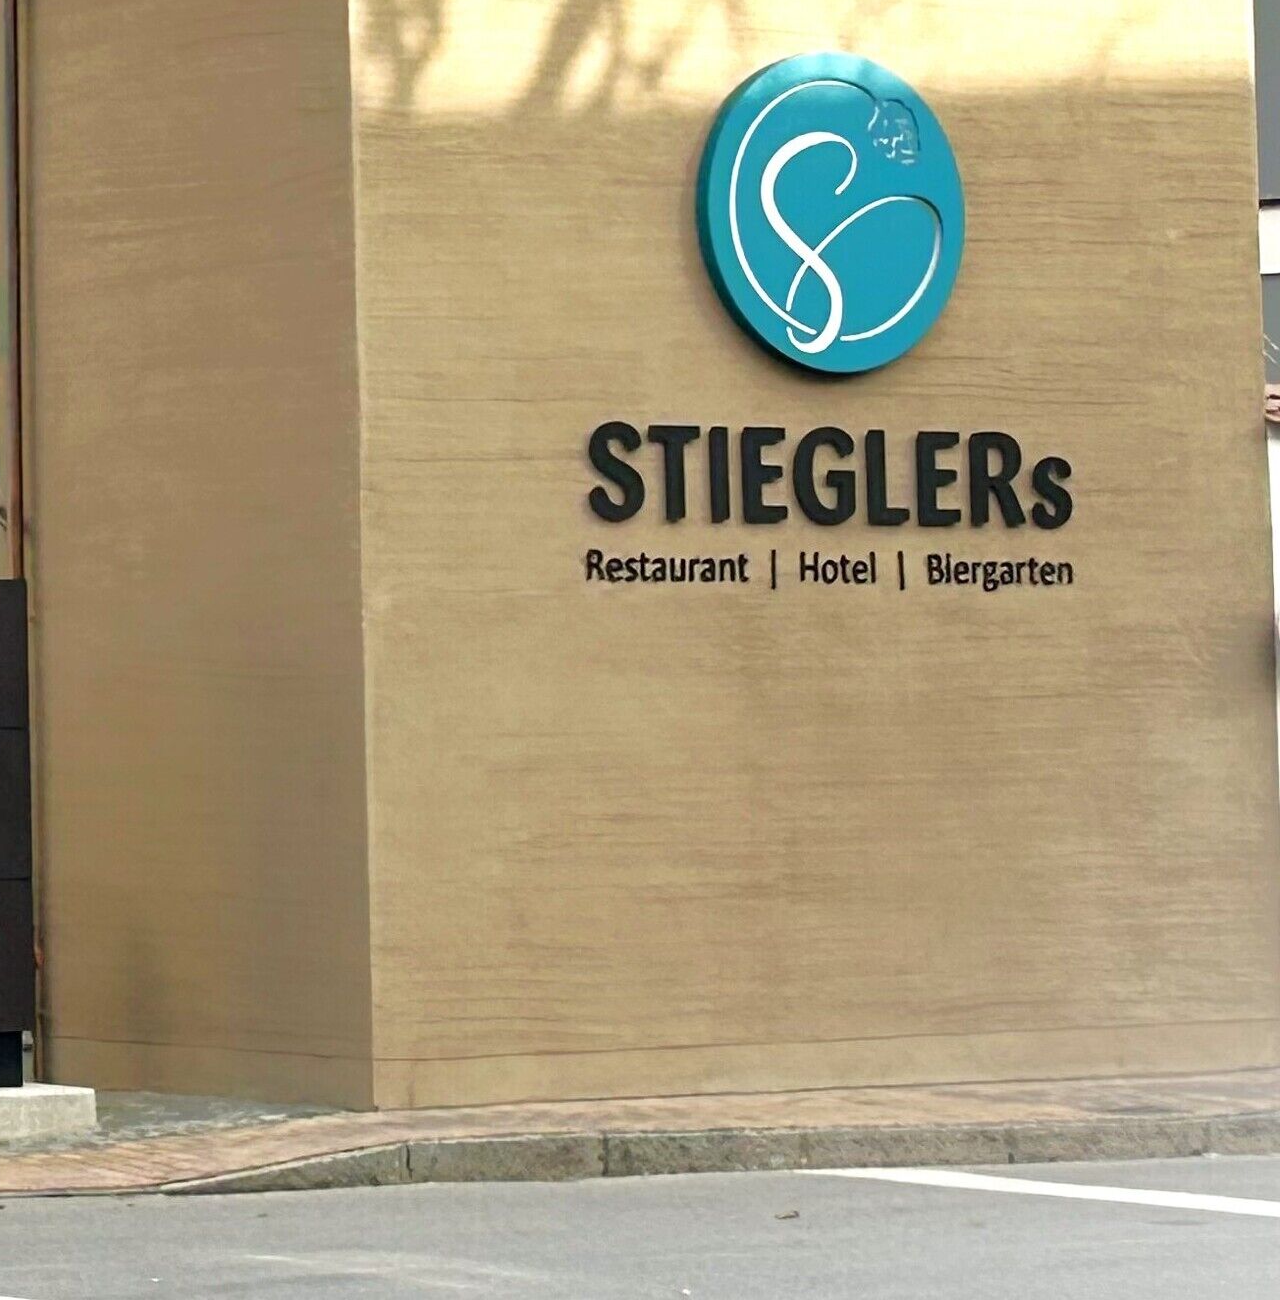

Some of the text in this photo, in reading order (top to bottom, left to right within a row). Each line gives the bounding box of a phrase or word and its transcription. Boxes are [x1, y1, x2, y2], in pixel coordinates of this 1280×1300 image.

[588, 421, 1073, 529] STIEGLERs
[586, 549, 750, 583] Restaurant
[799, 551, 876, 584] Hotel
[927, 553, 1074, 592] Biergarten
